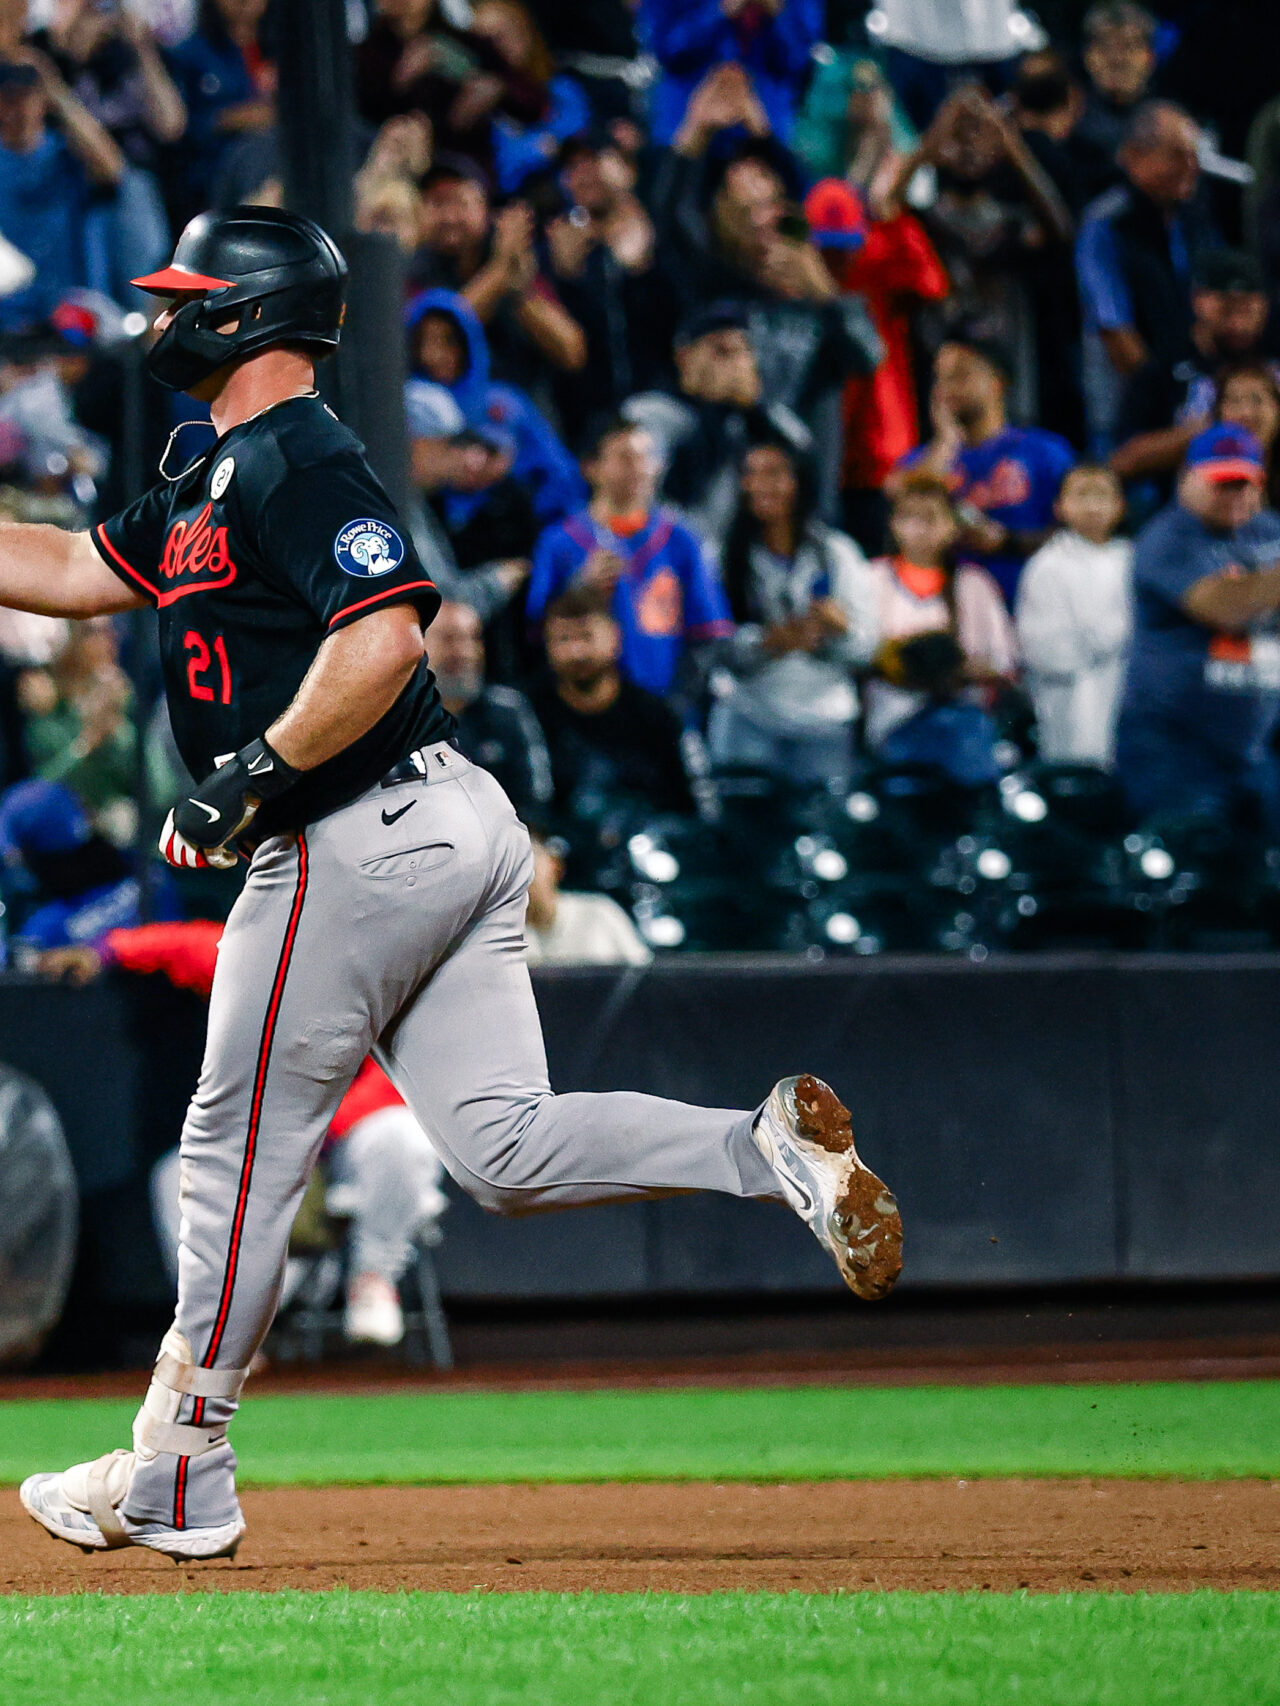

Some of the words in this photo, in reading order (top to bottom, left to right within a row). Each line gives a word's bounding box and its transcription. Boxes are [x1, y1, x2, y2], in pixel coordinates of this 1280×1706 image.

[216, 468, 230, 488] 21
[158, 501, 230, 580] oles
[339, 523, 367, 543] Rowe
[366, 521, 392, 539] Price
[183, 630, 232, 705] 21
